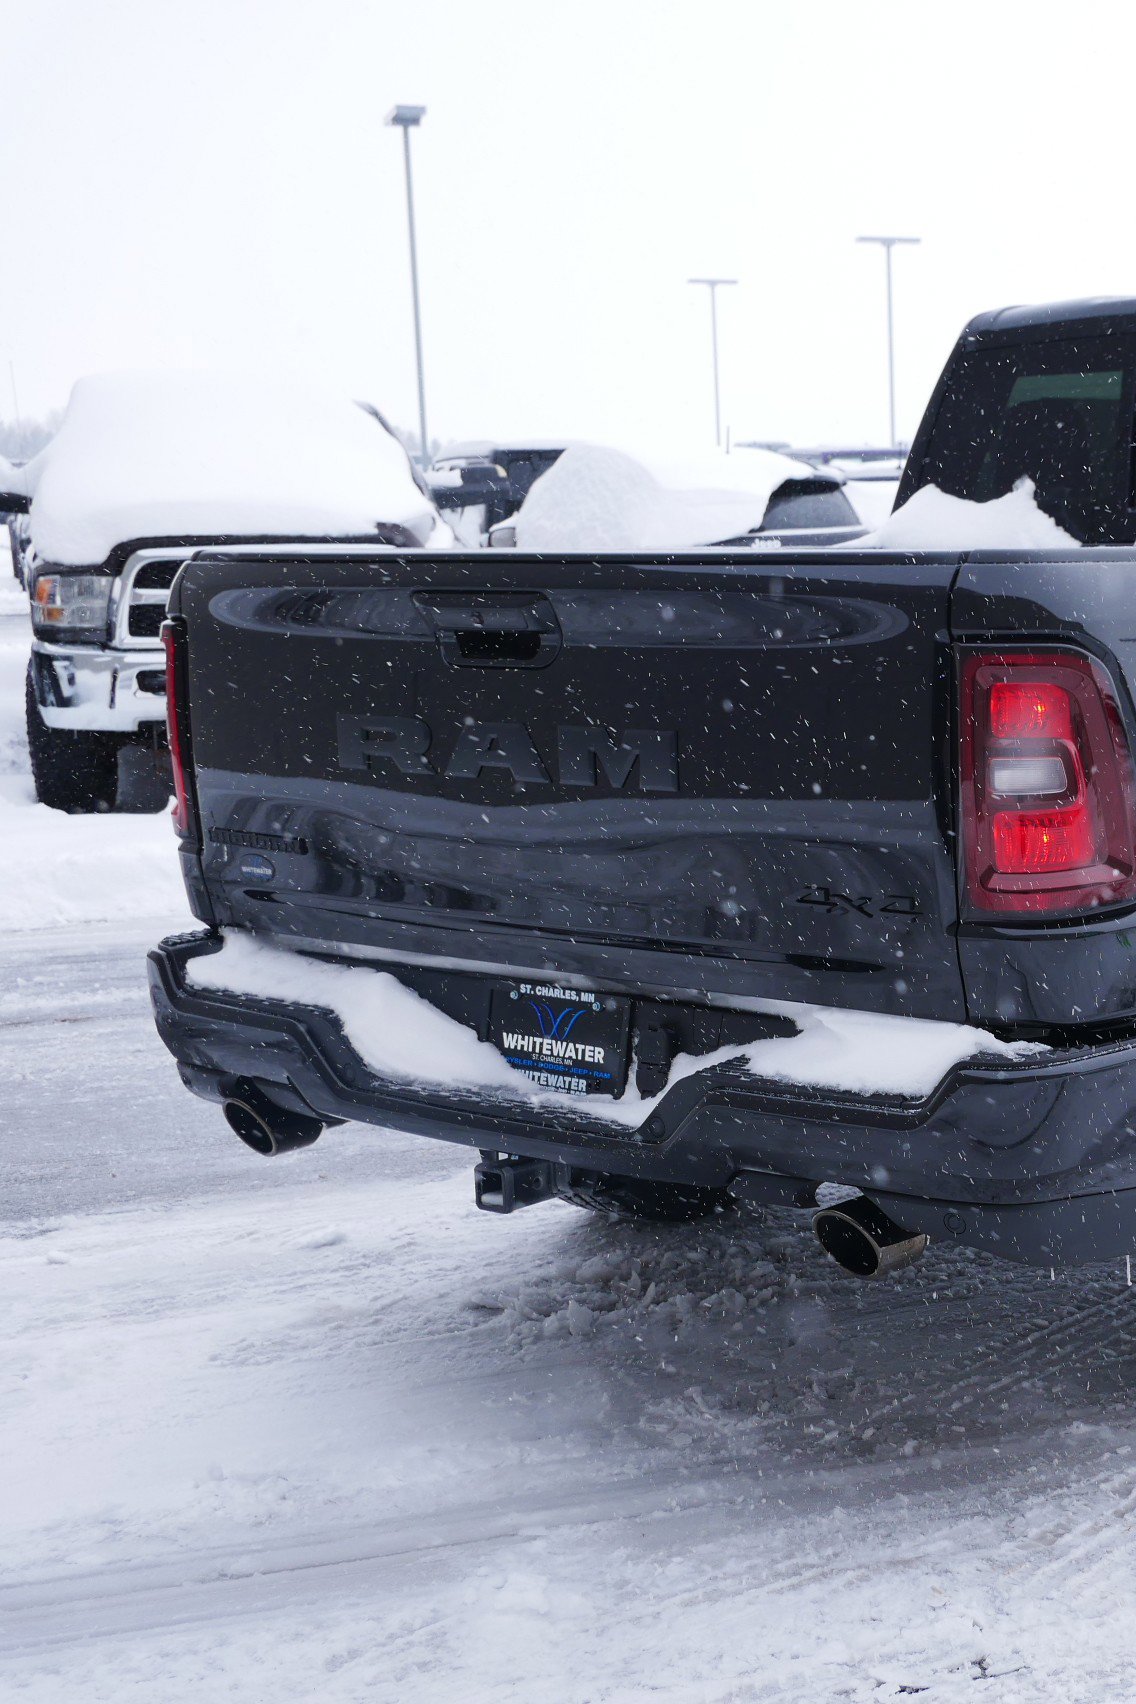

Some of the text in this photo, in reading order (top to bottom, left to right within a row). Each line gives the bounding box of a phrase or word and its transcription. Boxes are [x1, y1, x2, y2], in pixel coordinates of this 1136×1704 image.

[338, 714, 680, 792] RAM
[241, 866, 273, 875] WHITEWATER
[519, 983, 595, 1003] ST. CHARLES, MN
[502, 1032, 605, 1064] WHITEWATER
[506, 1056, 611, 1079] RYSLER DODGE JEEP RAM
[564, 1058, 573, 1066] MN
[514, 1068, 587, 1092] HITEWATER
